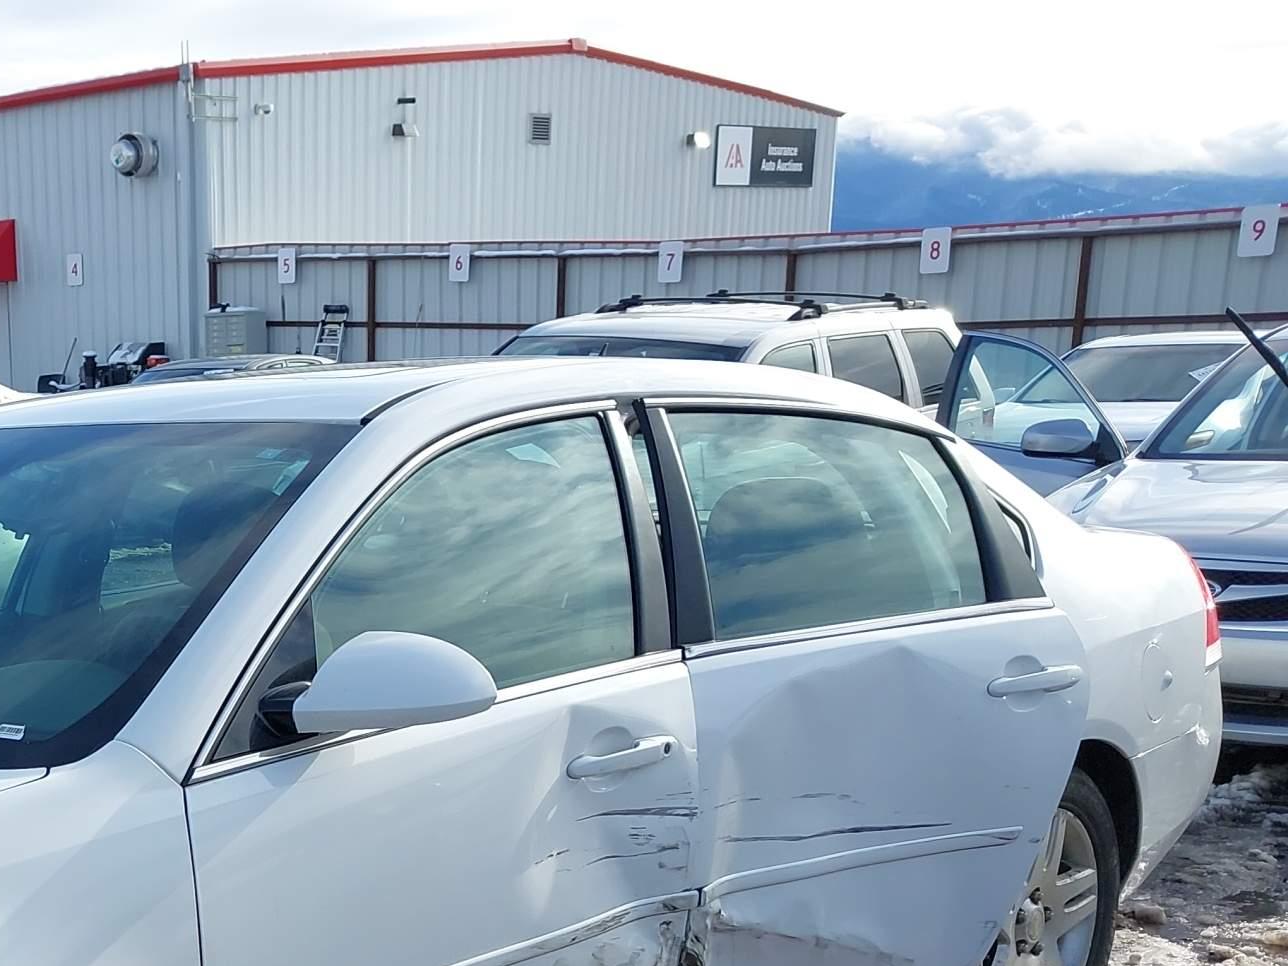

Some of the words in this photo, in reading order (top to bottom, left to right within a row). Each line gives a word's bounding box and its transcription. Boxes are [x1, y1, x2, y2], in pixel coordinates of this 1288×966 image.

[767, 143, 799, 156] Insurance
[760, 158, 776, 172] Auto
[776, 158, 804, 172] Auctions
[1253, 219, 1266, 241] 9
[930, 240, 941, 260] 8
[283, 258, 290, 273] 5
[455, 256, 463, 271] 6
[666, 253, 675, 271] 7
[71, 263, 78, 277] 4
